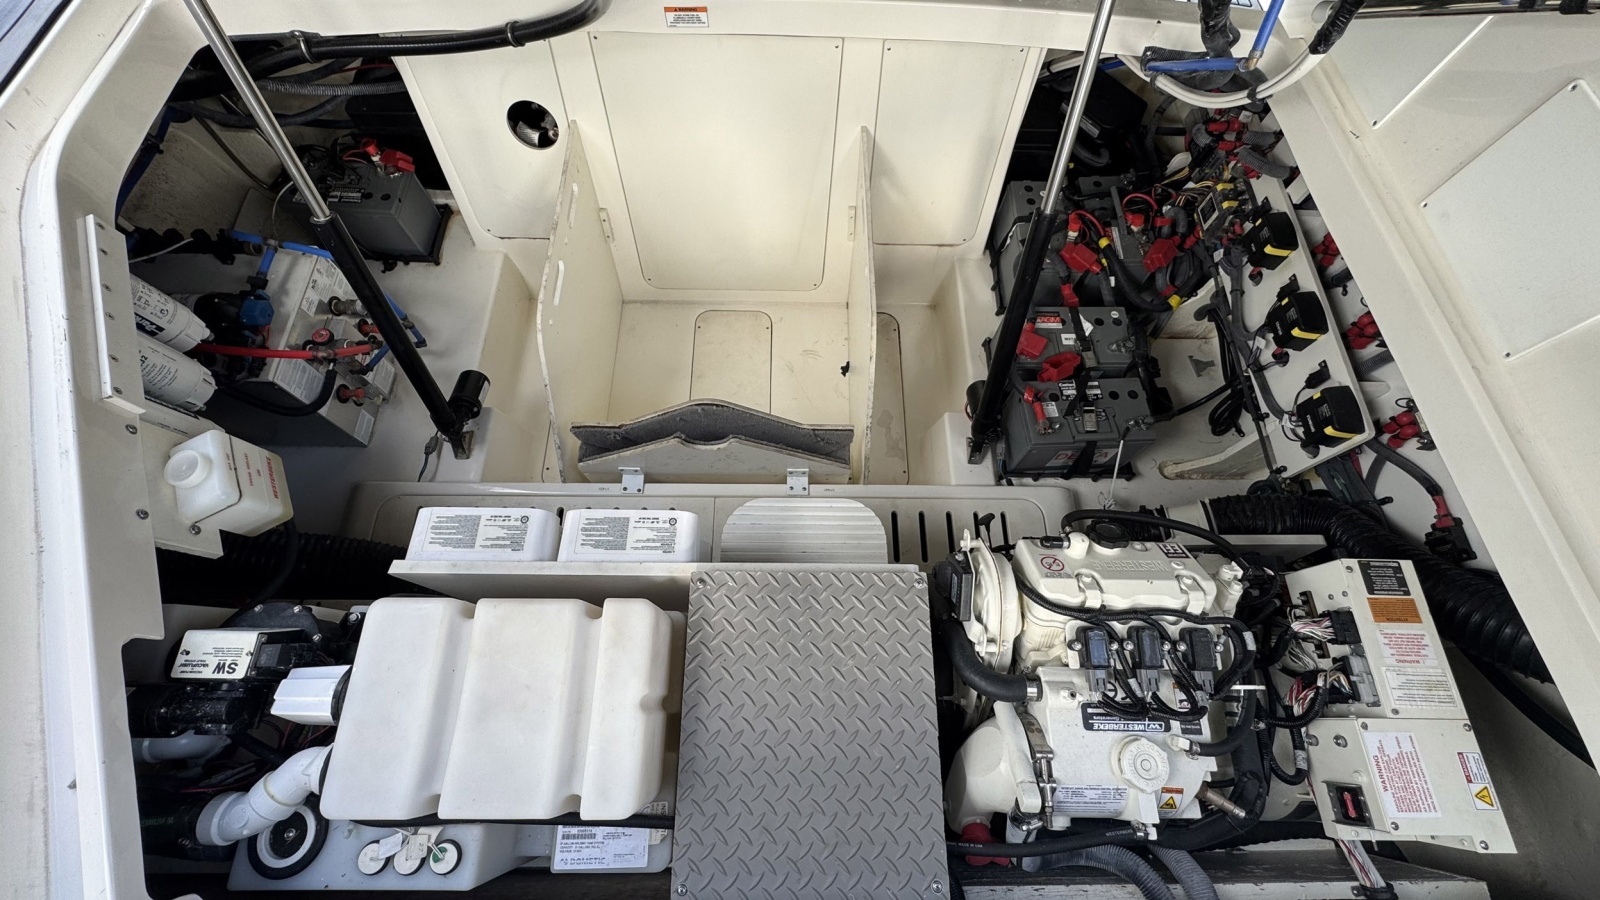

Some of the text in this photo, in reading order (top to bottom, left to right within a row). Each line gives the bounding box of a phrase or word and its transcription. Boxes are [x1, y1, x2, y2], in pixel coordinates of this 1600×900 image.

[1054, 452, 1108, 460] DEA
[266, 456, 279, 499] WESTERBEKE
[1158, 544, 1183, 553] EFI
[1092, 560, 1168, 571] WESTERBEKE
[211, 661, 239, 674] SW
[1372, 754, 1389, 791] WARNING
